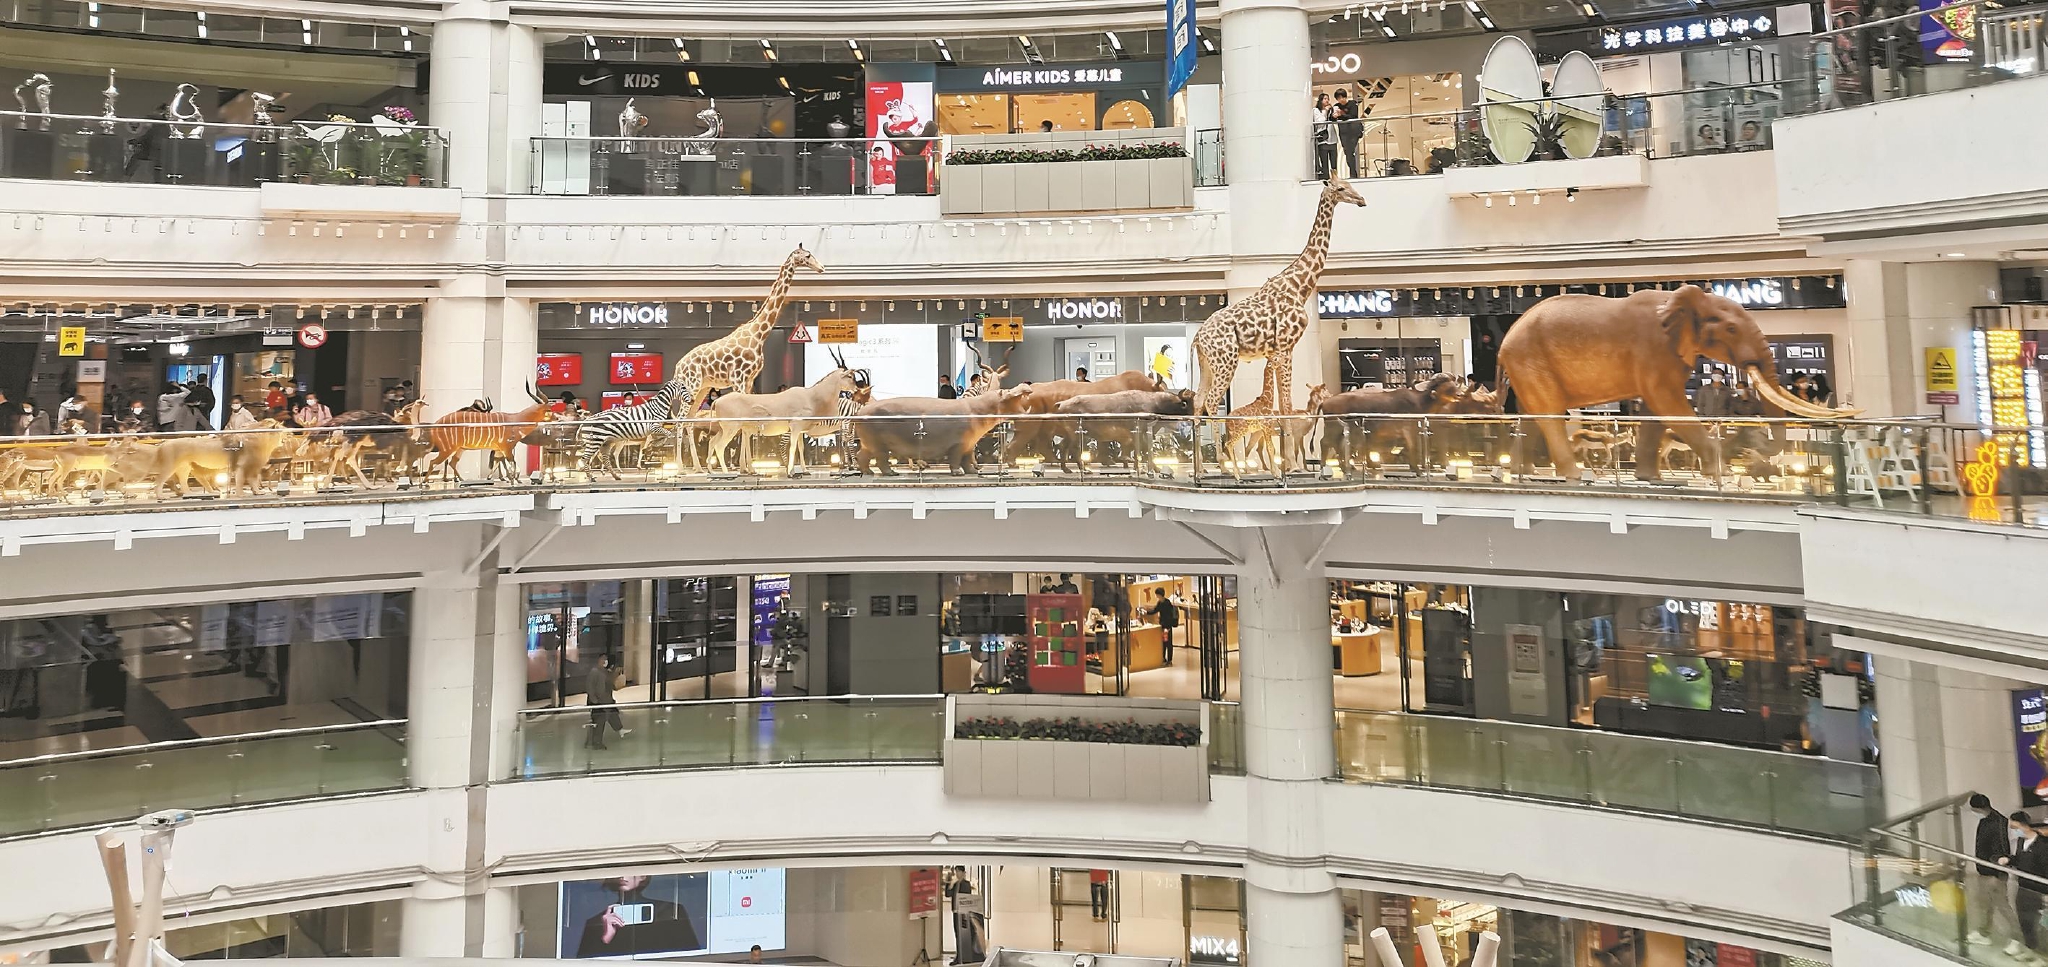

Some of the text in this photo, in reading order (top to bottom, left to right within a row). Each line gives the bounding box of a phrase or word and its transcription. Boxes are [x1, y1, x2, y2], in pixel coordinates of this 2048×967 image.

[623, 73, 660, 88] KIDS
[1034, 69, 1071, 84] KIDS
[1073, 68, 1123, 83] 爱慕儿童
[823, 91, 841, 101] KIDS
[589, 306, 669, 324] HONOR
[1048, 301, 1122, 319] HONOR
[1665, 598, 1712, 616] OLED
